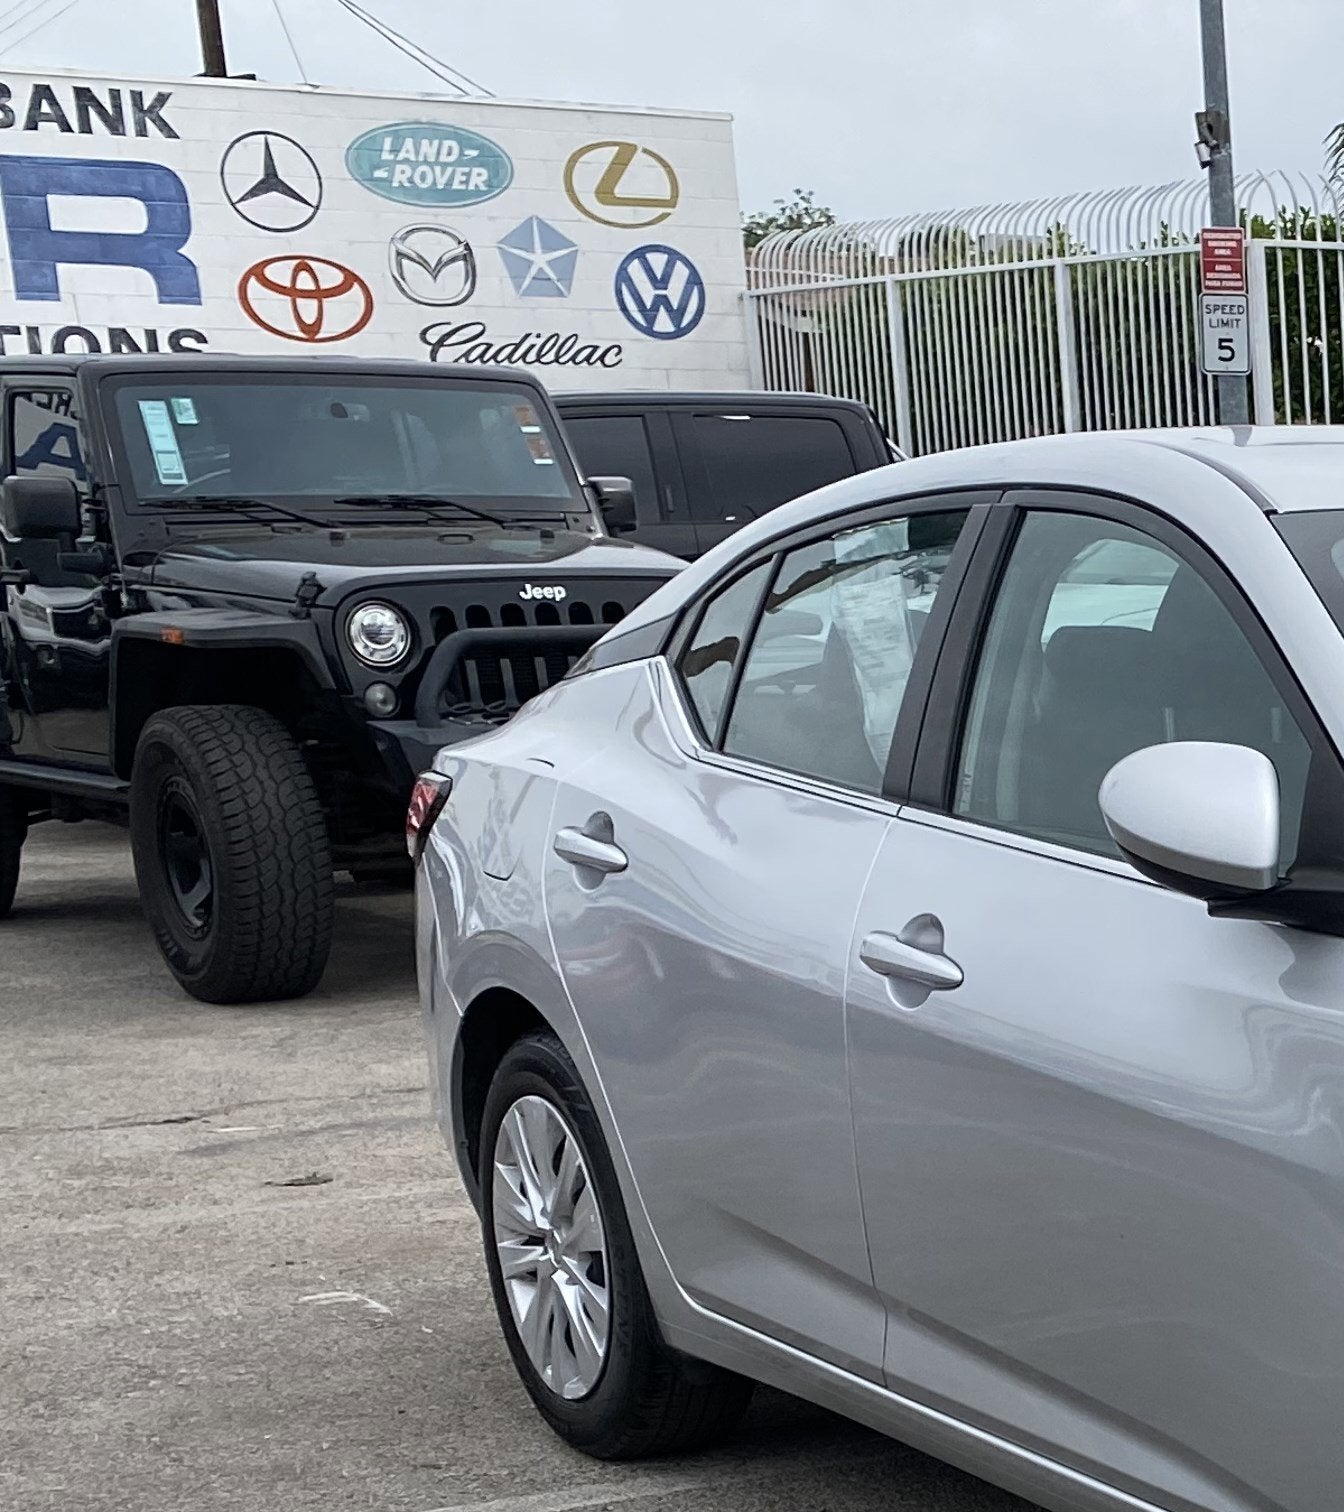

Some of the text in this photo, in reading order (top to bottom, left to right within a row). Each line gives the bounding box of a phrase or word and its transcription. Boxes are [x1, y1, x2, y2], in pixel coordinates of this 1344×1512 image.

[381, 136, 458, 163] LAND
[392, 164, 488, 191] ROVER
[1205, 303, 1245, 315] SPEED
[1208, 317, 1241, 329] LIMIT
[419, 321, 623, 368] Cadillac
[1217, 337, 1235, 362] 5
[519, 583, 567, 601] Jeep
